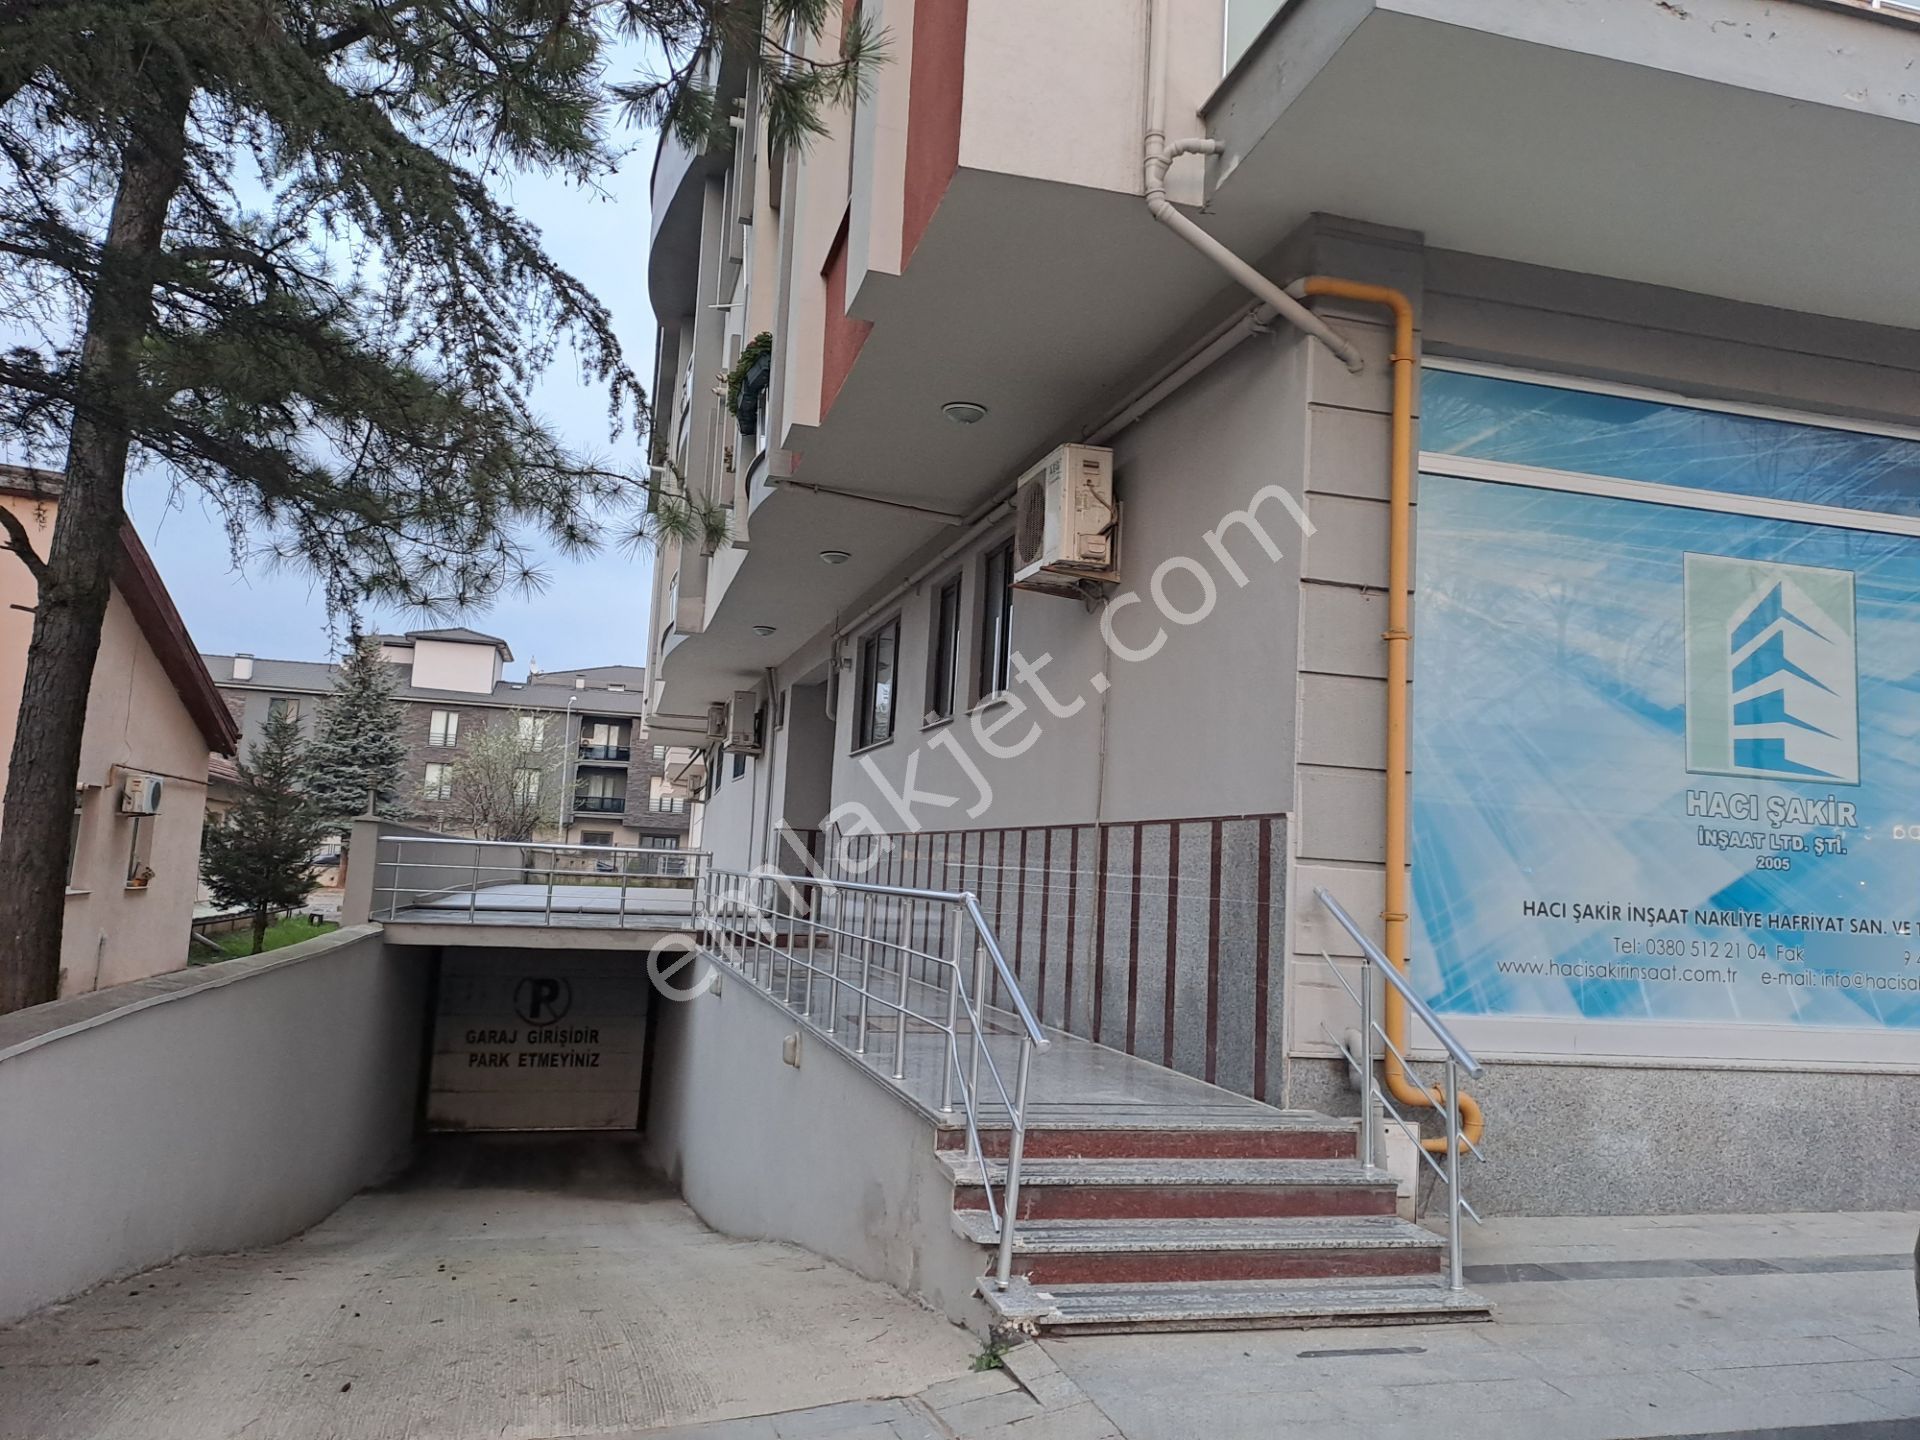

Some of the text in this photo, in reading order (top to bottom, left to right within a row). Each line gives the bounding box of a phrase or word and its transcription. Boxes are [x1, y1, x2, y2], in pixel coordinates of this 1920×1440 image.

[1686, 789, 1859, 829] HACI ŞAKİR
[1697, 825, 1848, 856] İNŞAAT LTD. ŞTİ.
[1756, 856, 1790, 871] 2005
[1523, 900, 1567, 918] HACI
[1572, 900, 1622, 924] ŞAKİR
[1627, 902, 1689, 927] İNŞAAT
[1695, 908, 1762, 928] NAKLİYE
[1768, 912, 1844, 932] HAFRİYAT
[1850, 918, 1887, 934] SAN.
[1892, 920, 1911, 935] VE
[1613, 937, 1641, 954] Tel:
[1646, 938, 1686, 957] 0380
[1691, 941, 1719, 958] 512
[1724, 942, 1740, 958] 21
[1747, 943, 1766, 960] 04
[1497, 959, 1920, 991] www.hacisakirinsaat.com.tr e-mail: info@hacisa
[465, 1026, 600, 1047] GARAJ GİRİŞİDİR
[468, 1049, 600, 1068] PARK ETMEYİNİZ
